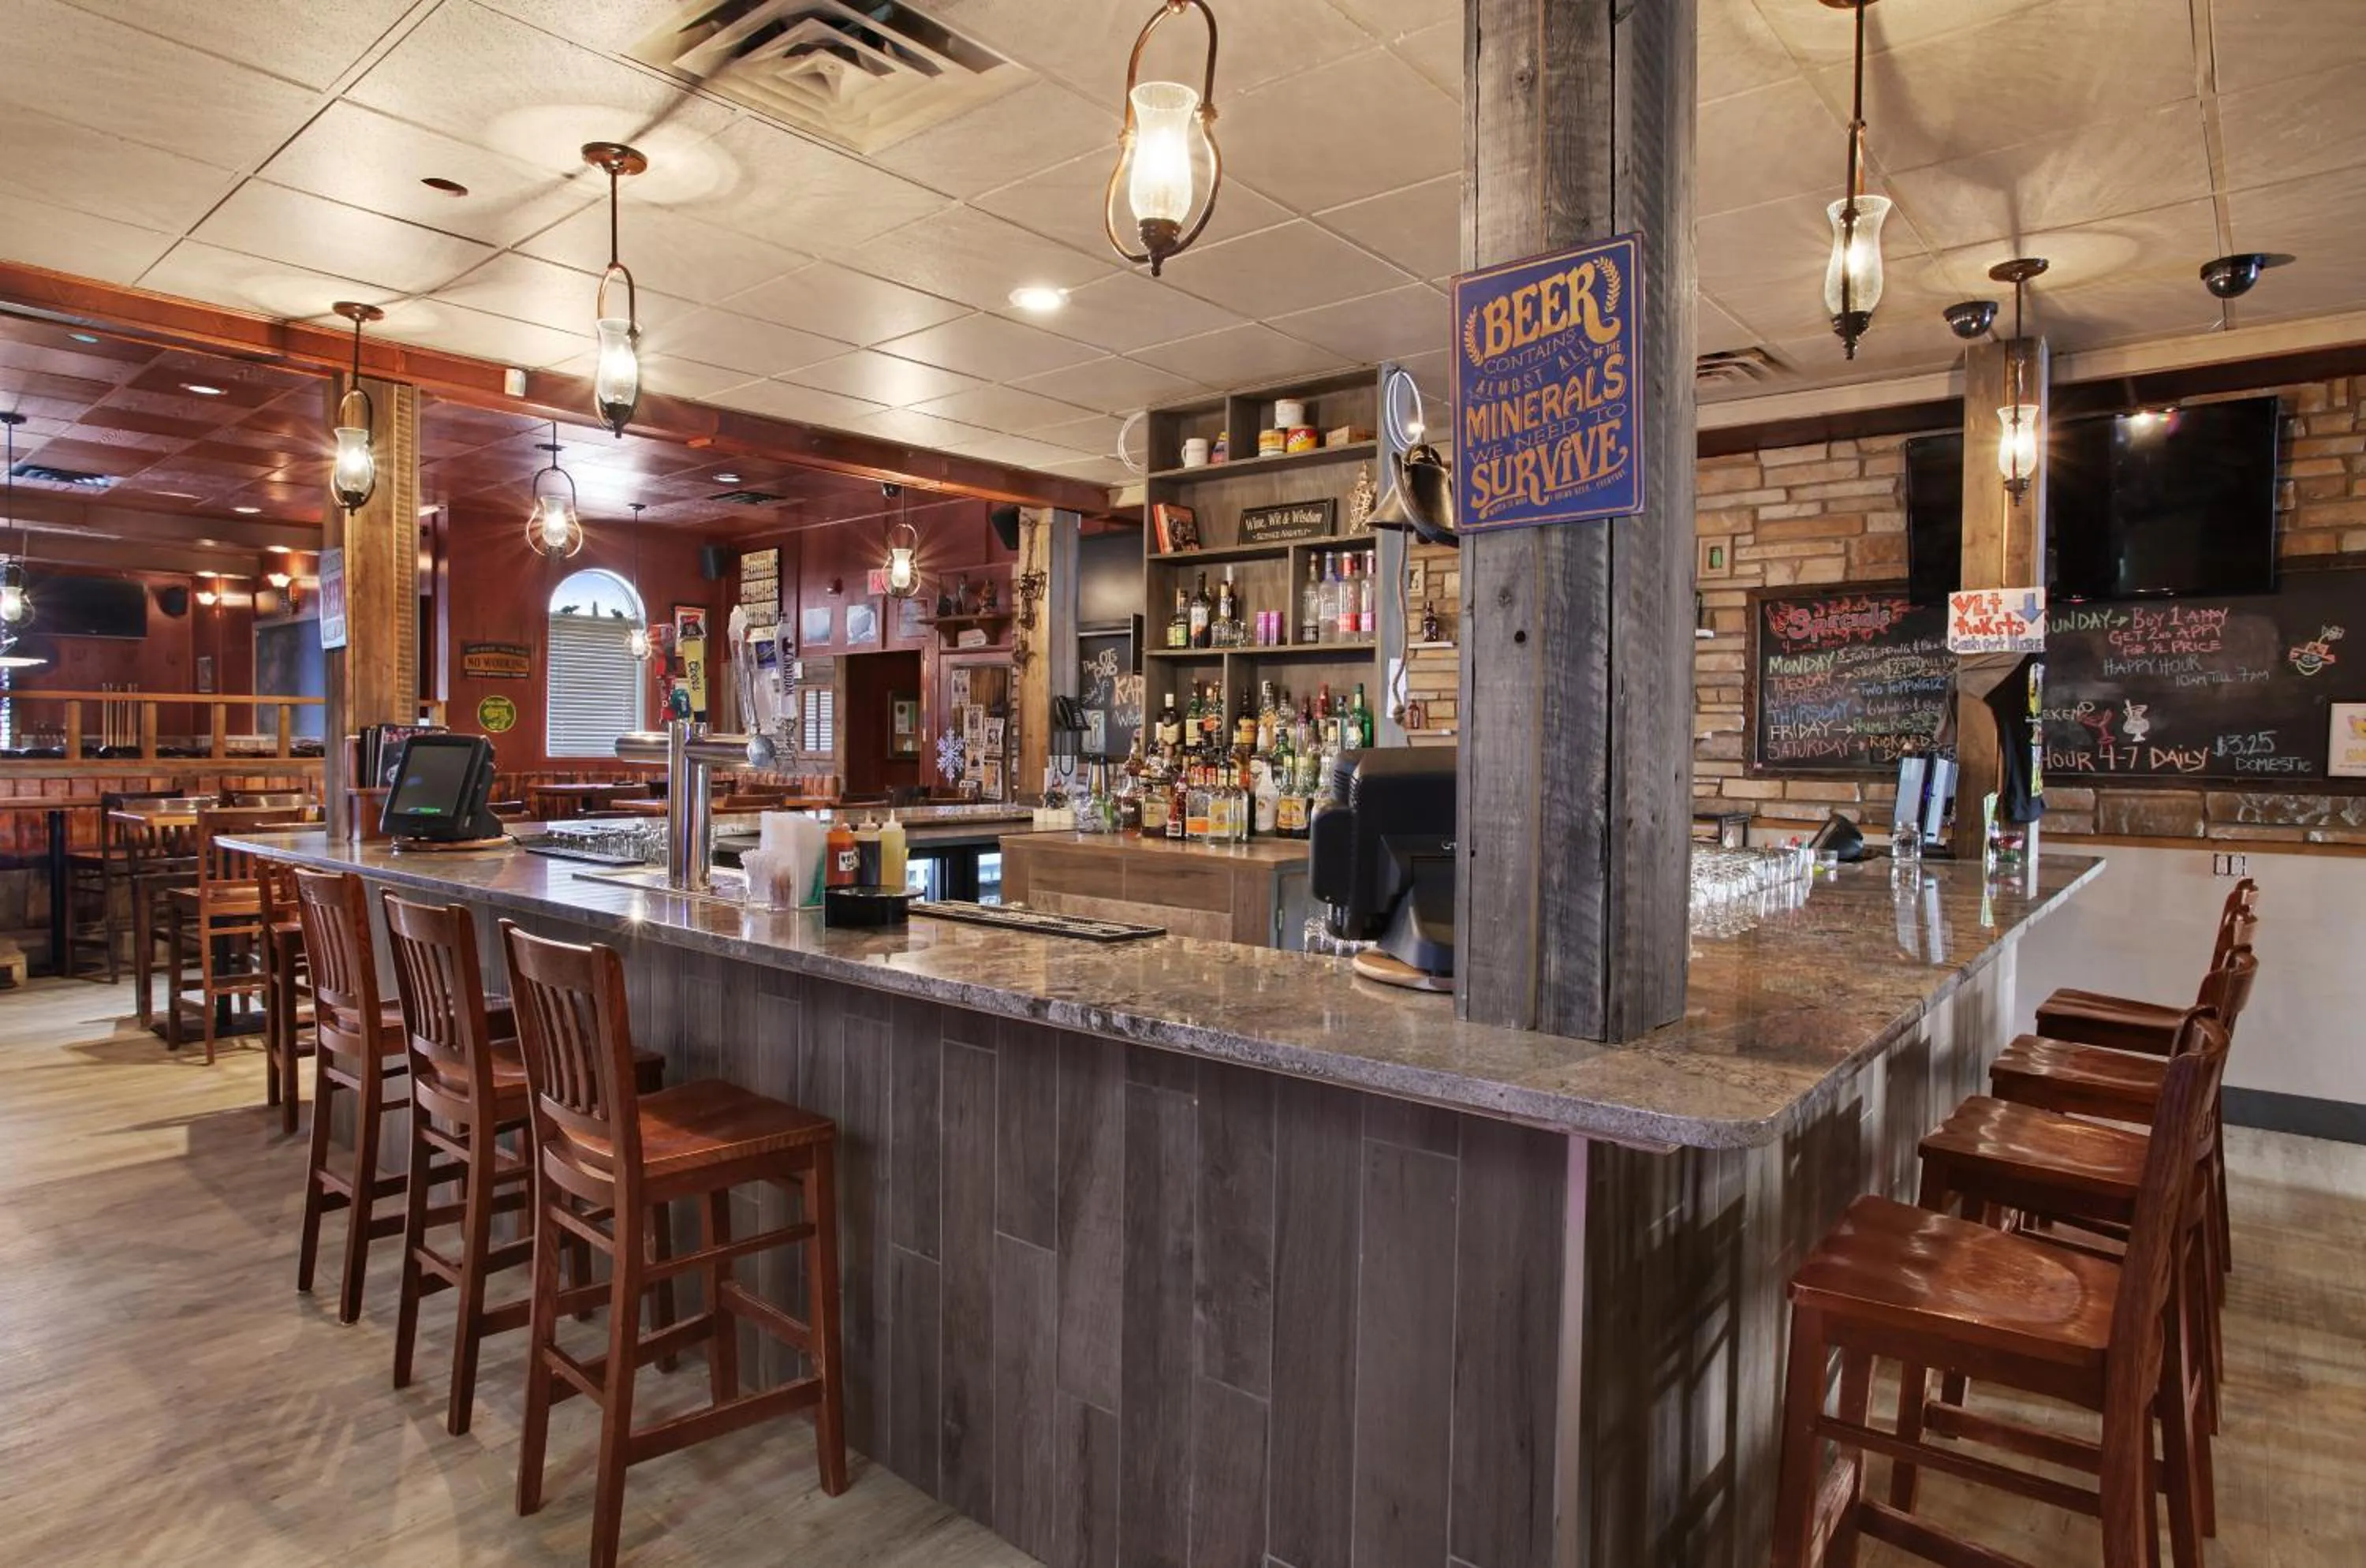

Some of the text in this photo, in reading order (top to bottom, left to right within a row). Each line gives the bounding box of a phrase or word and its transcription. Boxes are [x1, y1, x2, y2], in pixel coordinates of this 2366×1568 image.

[1483, 261, 1621, 360] BEER
[1483, 328, 1577, 375] CONTAINS
[1476, 337, 1621, 396] ALMOST ALL OF THE
[1466, 354, 1627, 448] MINERALS
[1469, 402, 1627, 465] WE NEED TO
[1470, 419, 1629, 511] SURVIVE
[2131, 607, 2165, 630] BUY
[2170, 605, 2184, 626] 1
[2185, 607, 2229, 626] APPY
[2108, 629, 2143, 647] GET
[2175, 624, 2222, 639] APPY
[2170, 640, 2223, 654] PRICE
[1768, 651, 1836, 675] MONDAY
[2103, 654, 2204, 677] HAPPY HOUR
[2042, 701, 2095, 721] EKEND
[1770, 719, 1836, 741] FRIDAY
[1767, 734, 1853, 760] SATURDAY
[2215, 730, 2278, 757] $3.25
[2235, 756, 2312, 772] DOMESTIC
